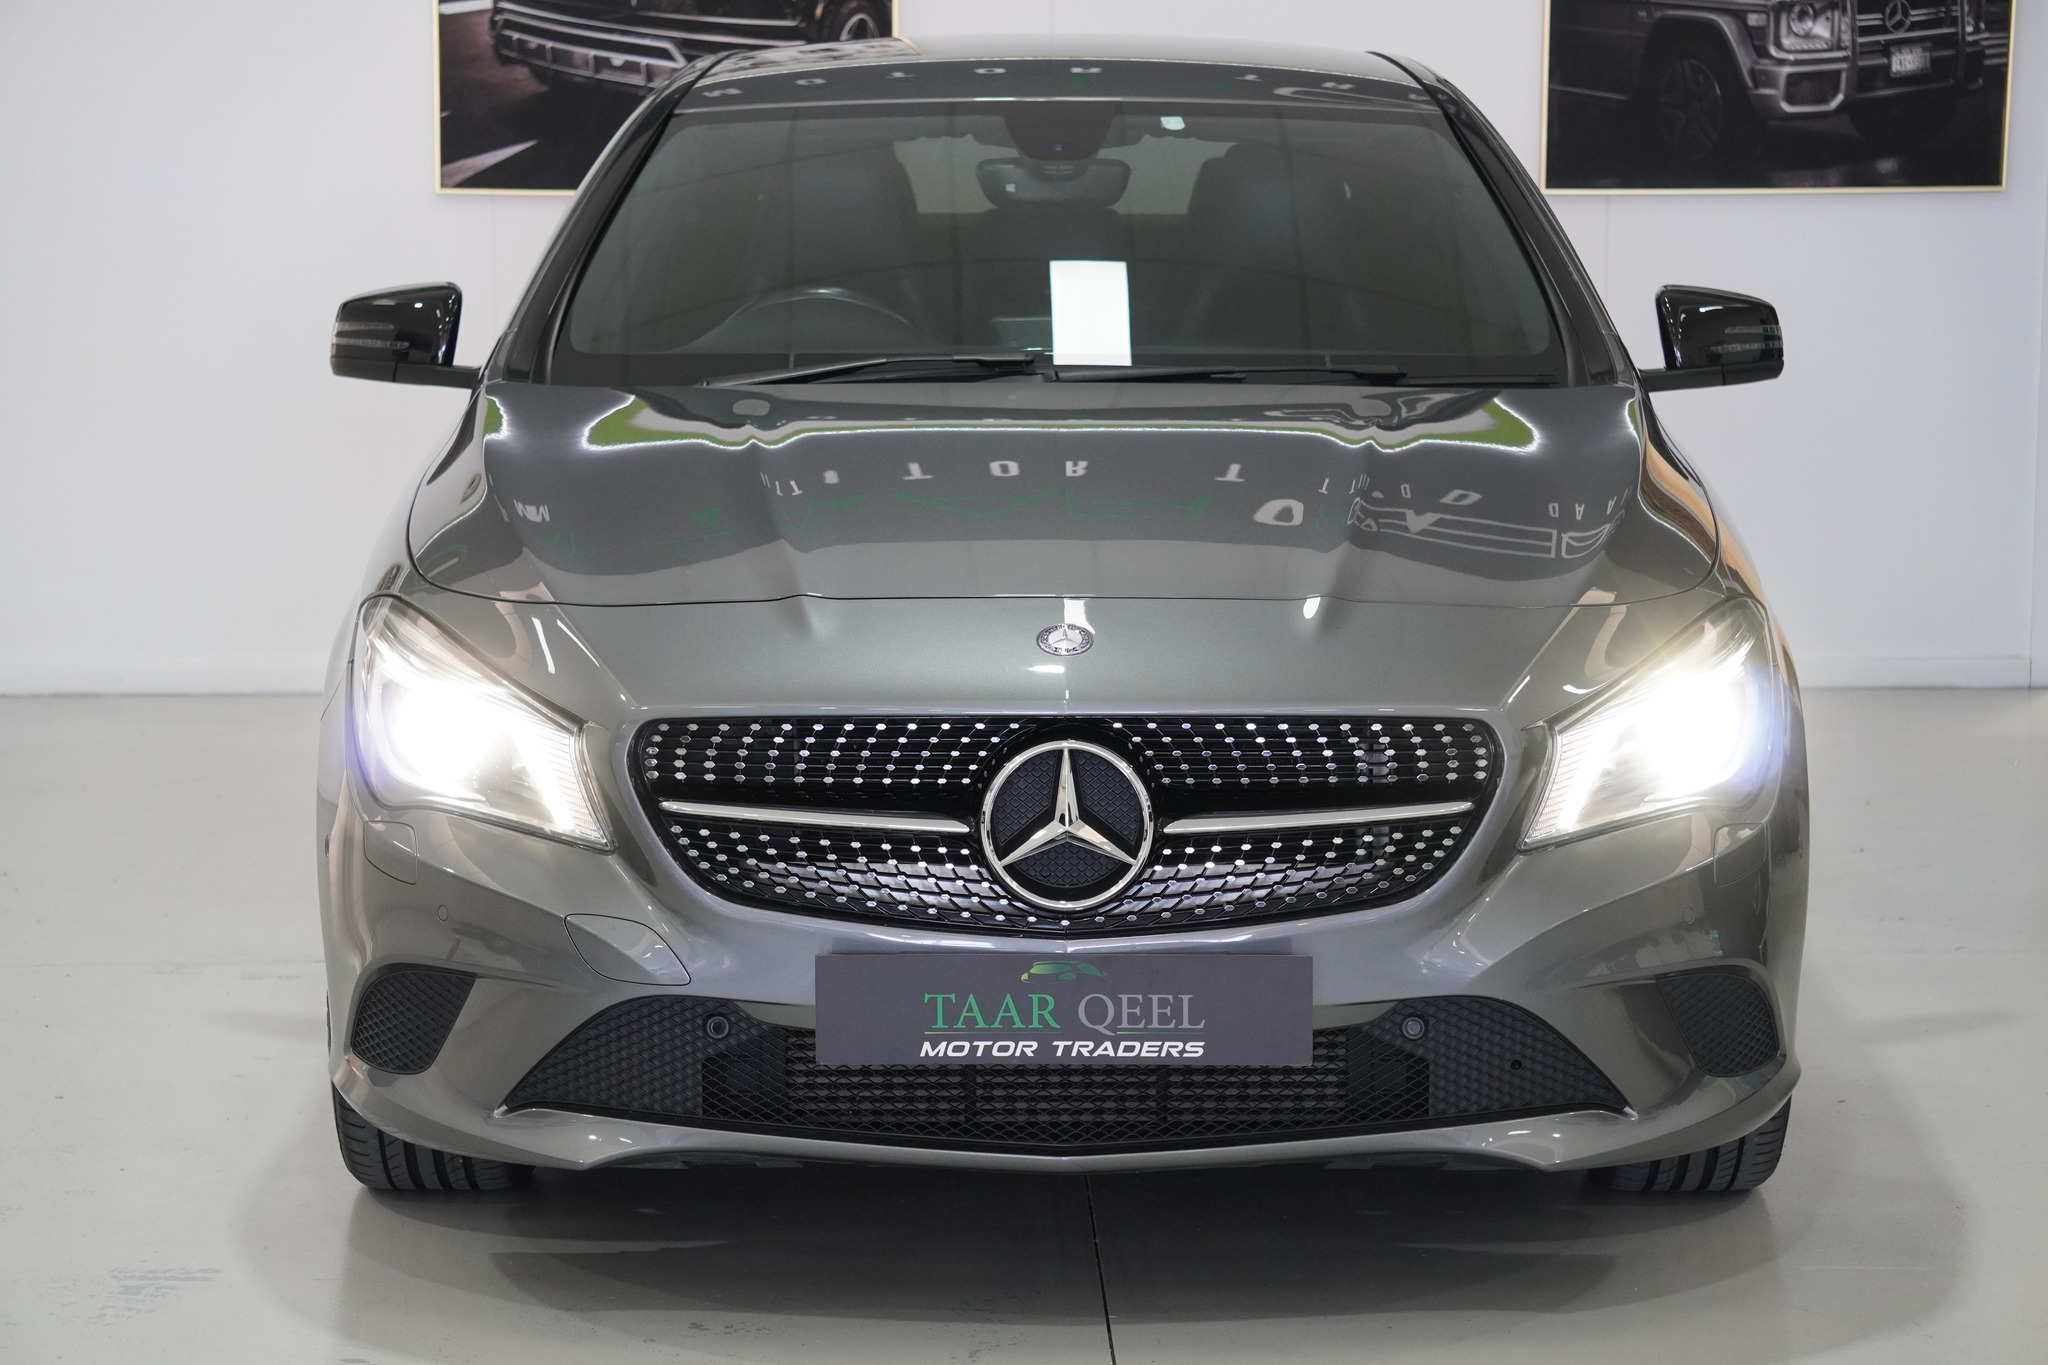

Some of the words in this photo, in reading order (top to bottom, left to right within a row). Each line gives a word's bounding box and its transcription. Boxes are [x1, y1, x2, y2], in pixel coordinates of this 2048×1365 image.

[924, 993, 1060, 1029] TAAR
[1078, 993, 1205, 1036] QEEL
[920, 1040, 1039, 1058] MOTOR
[1052, 1040, 1205, 1058] TRADERS
